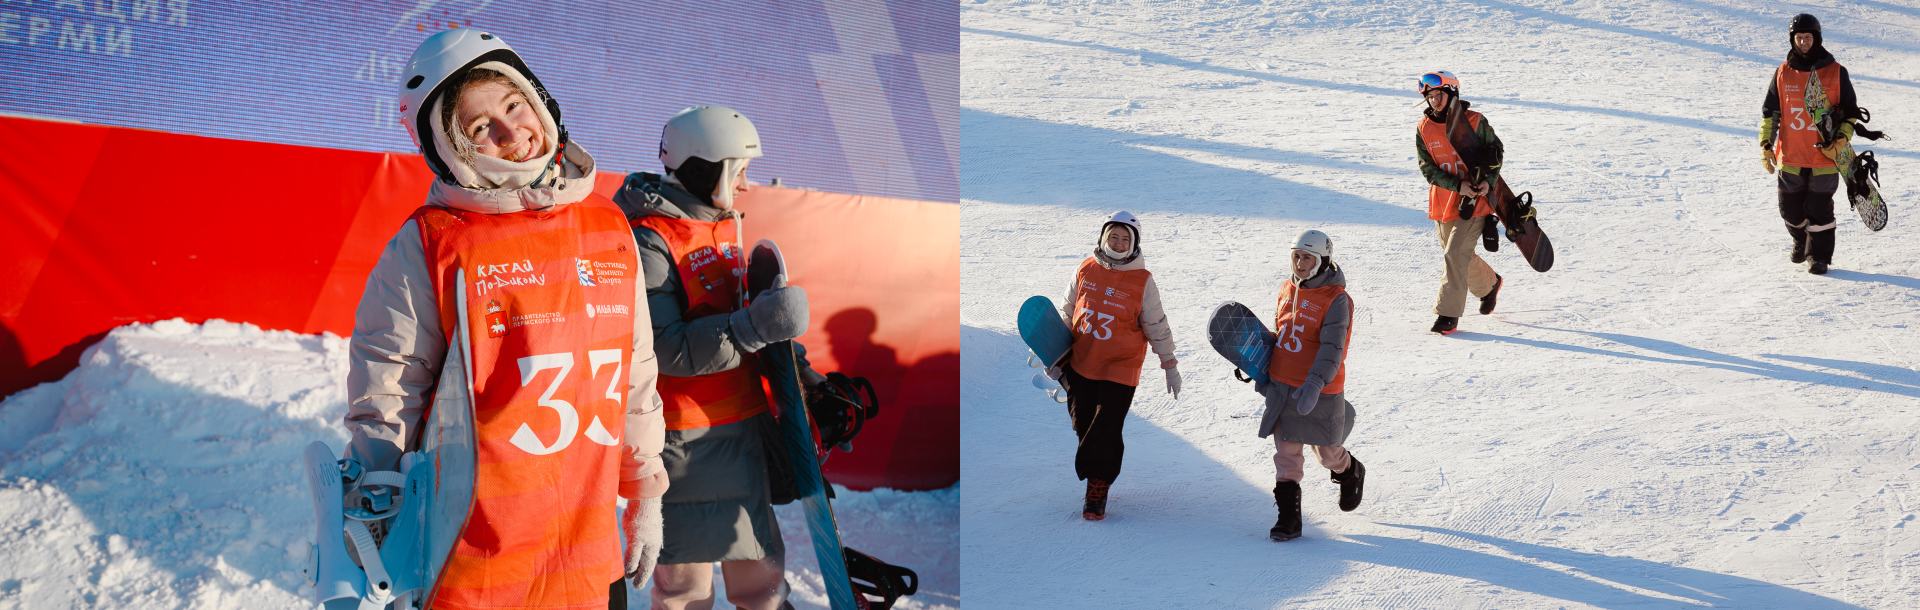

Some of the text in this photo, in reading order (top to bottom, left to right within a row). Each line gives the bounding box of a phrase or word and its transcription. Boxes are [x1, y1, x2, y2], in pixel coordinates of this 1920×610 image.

[477, 259, 534, 278] КАТАЙ
[595, 268, 624, 276] Зимнего
[597, 276, 622, 285] Спорта
[595, 304, 612, 314] ИЛЬЯ
[512, 311, 561, 322] ПРАВИТЕЛЬСТВО
[513, 318, 551, 328] ПЕРМСКОГО
[1078, 306, 1115, 340] 33
[1275, 322, 1305, 353] 15
[508, 348, 622, 456] 33
